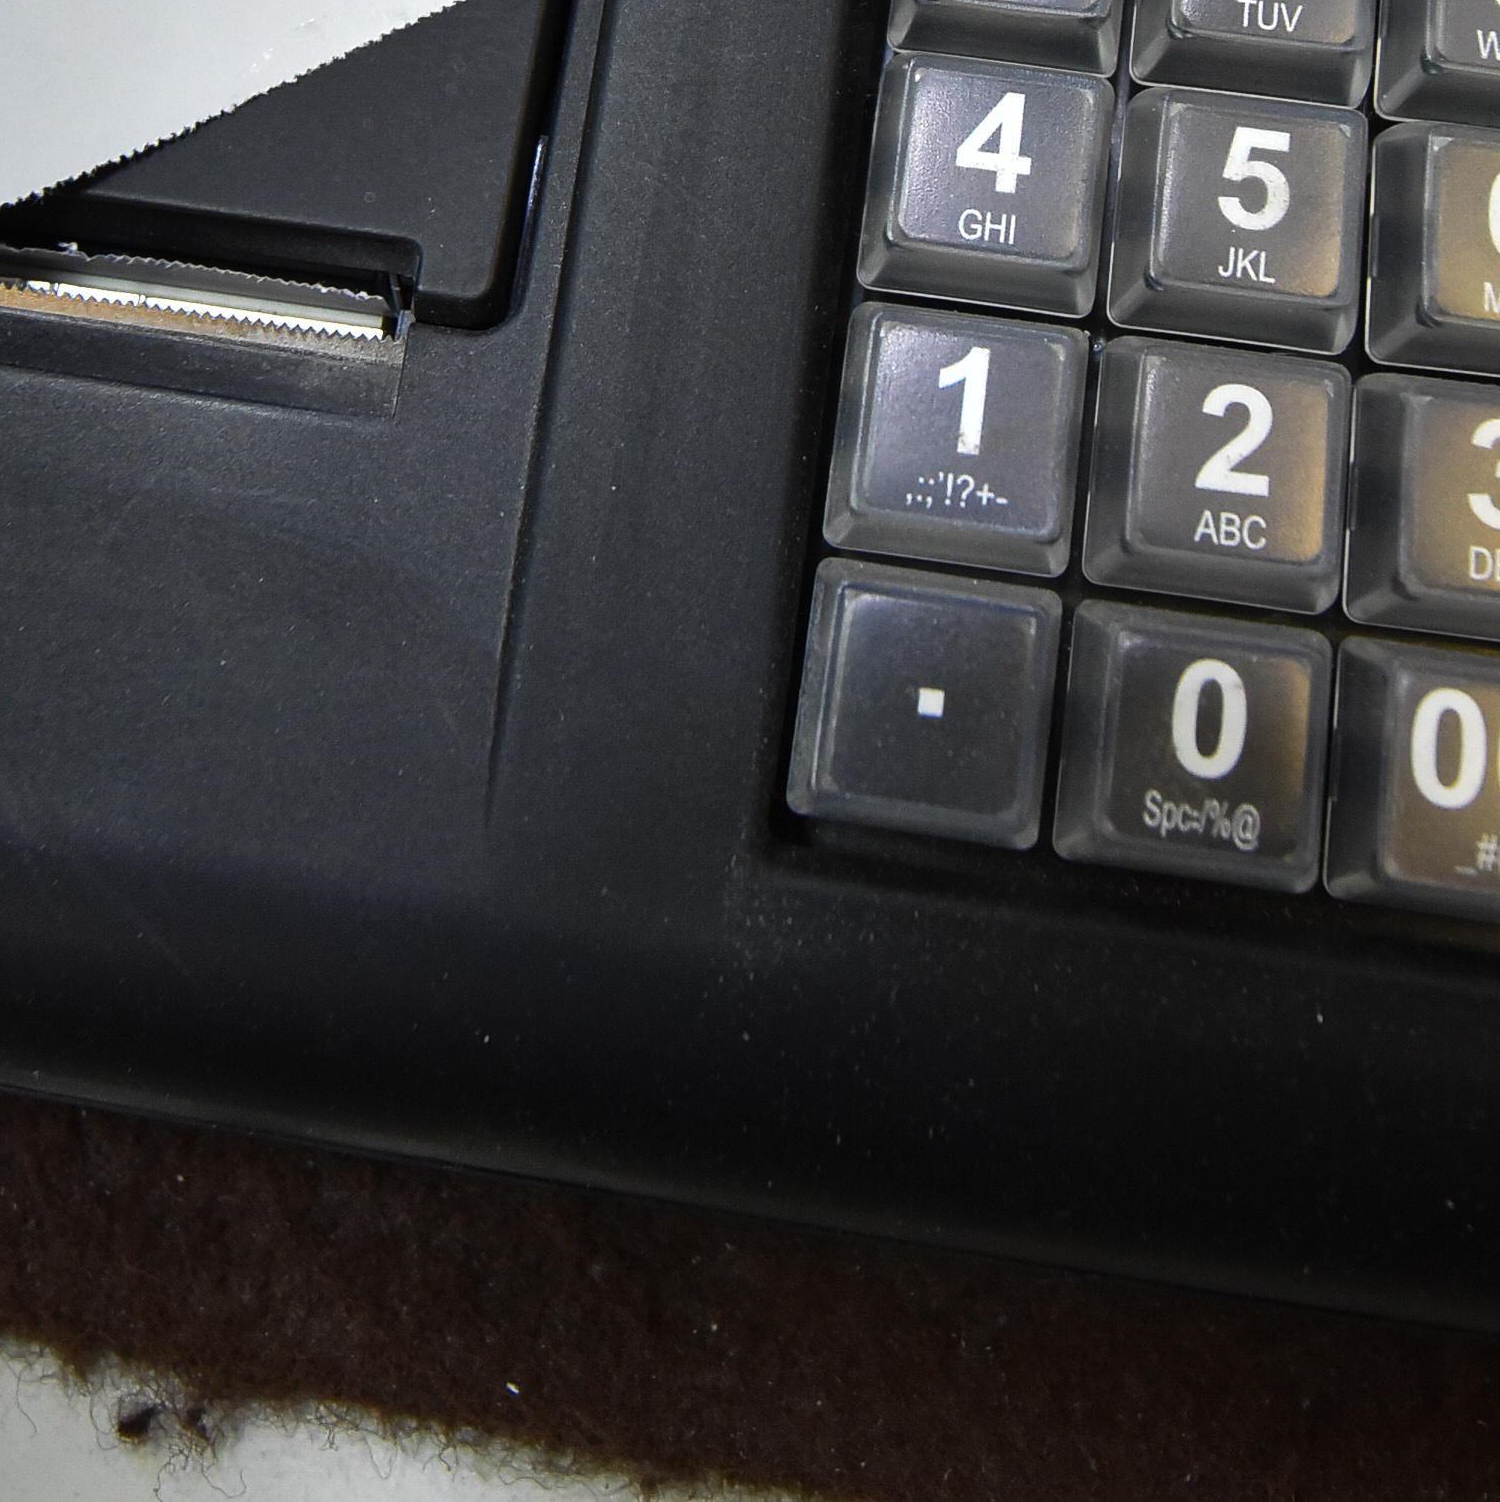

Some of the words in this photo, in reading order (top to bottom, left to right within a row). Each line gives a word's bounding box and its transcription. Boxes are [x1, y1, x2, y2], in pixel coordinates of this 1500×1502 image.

[954, 91, 1032, 195] 4
[1216, 126, 1292, 231] 5
[958, 208, 1016, 246] GHI
[1218, 245, 1277, 285] JKL
[938, 345, 990, 455] 1
[1193, 383, 1275, 497] 2
[1193, 508, 1268, 551] ABC
[1171, 657, 1248, 780] 0
